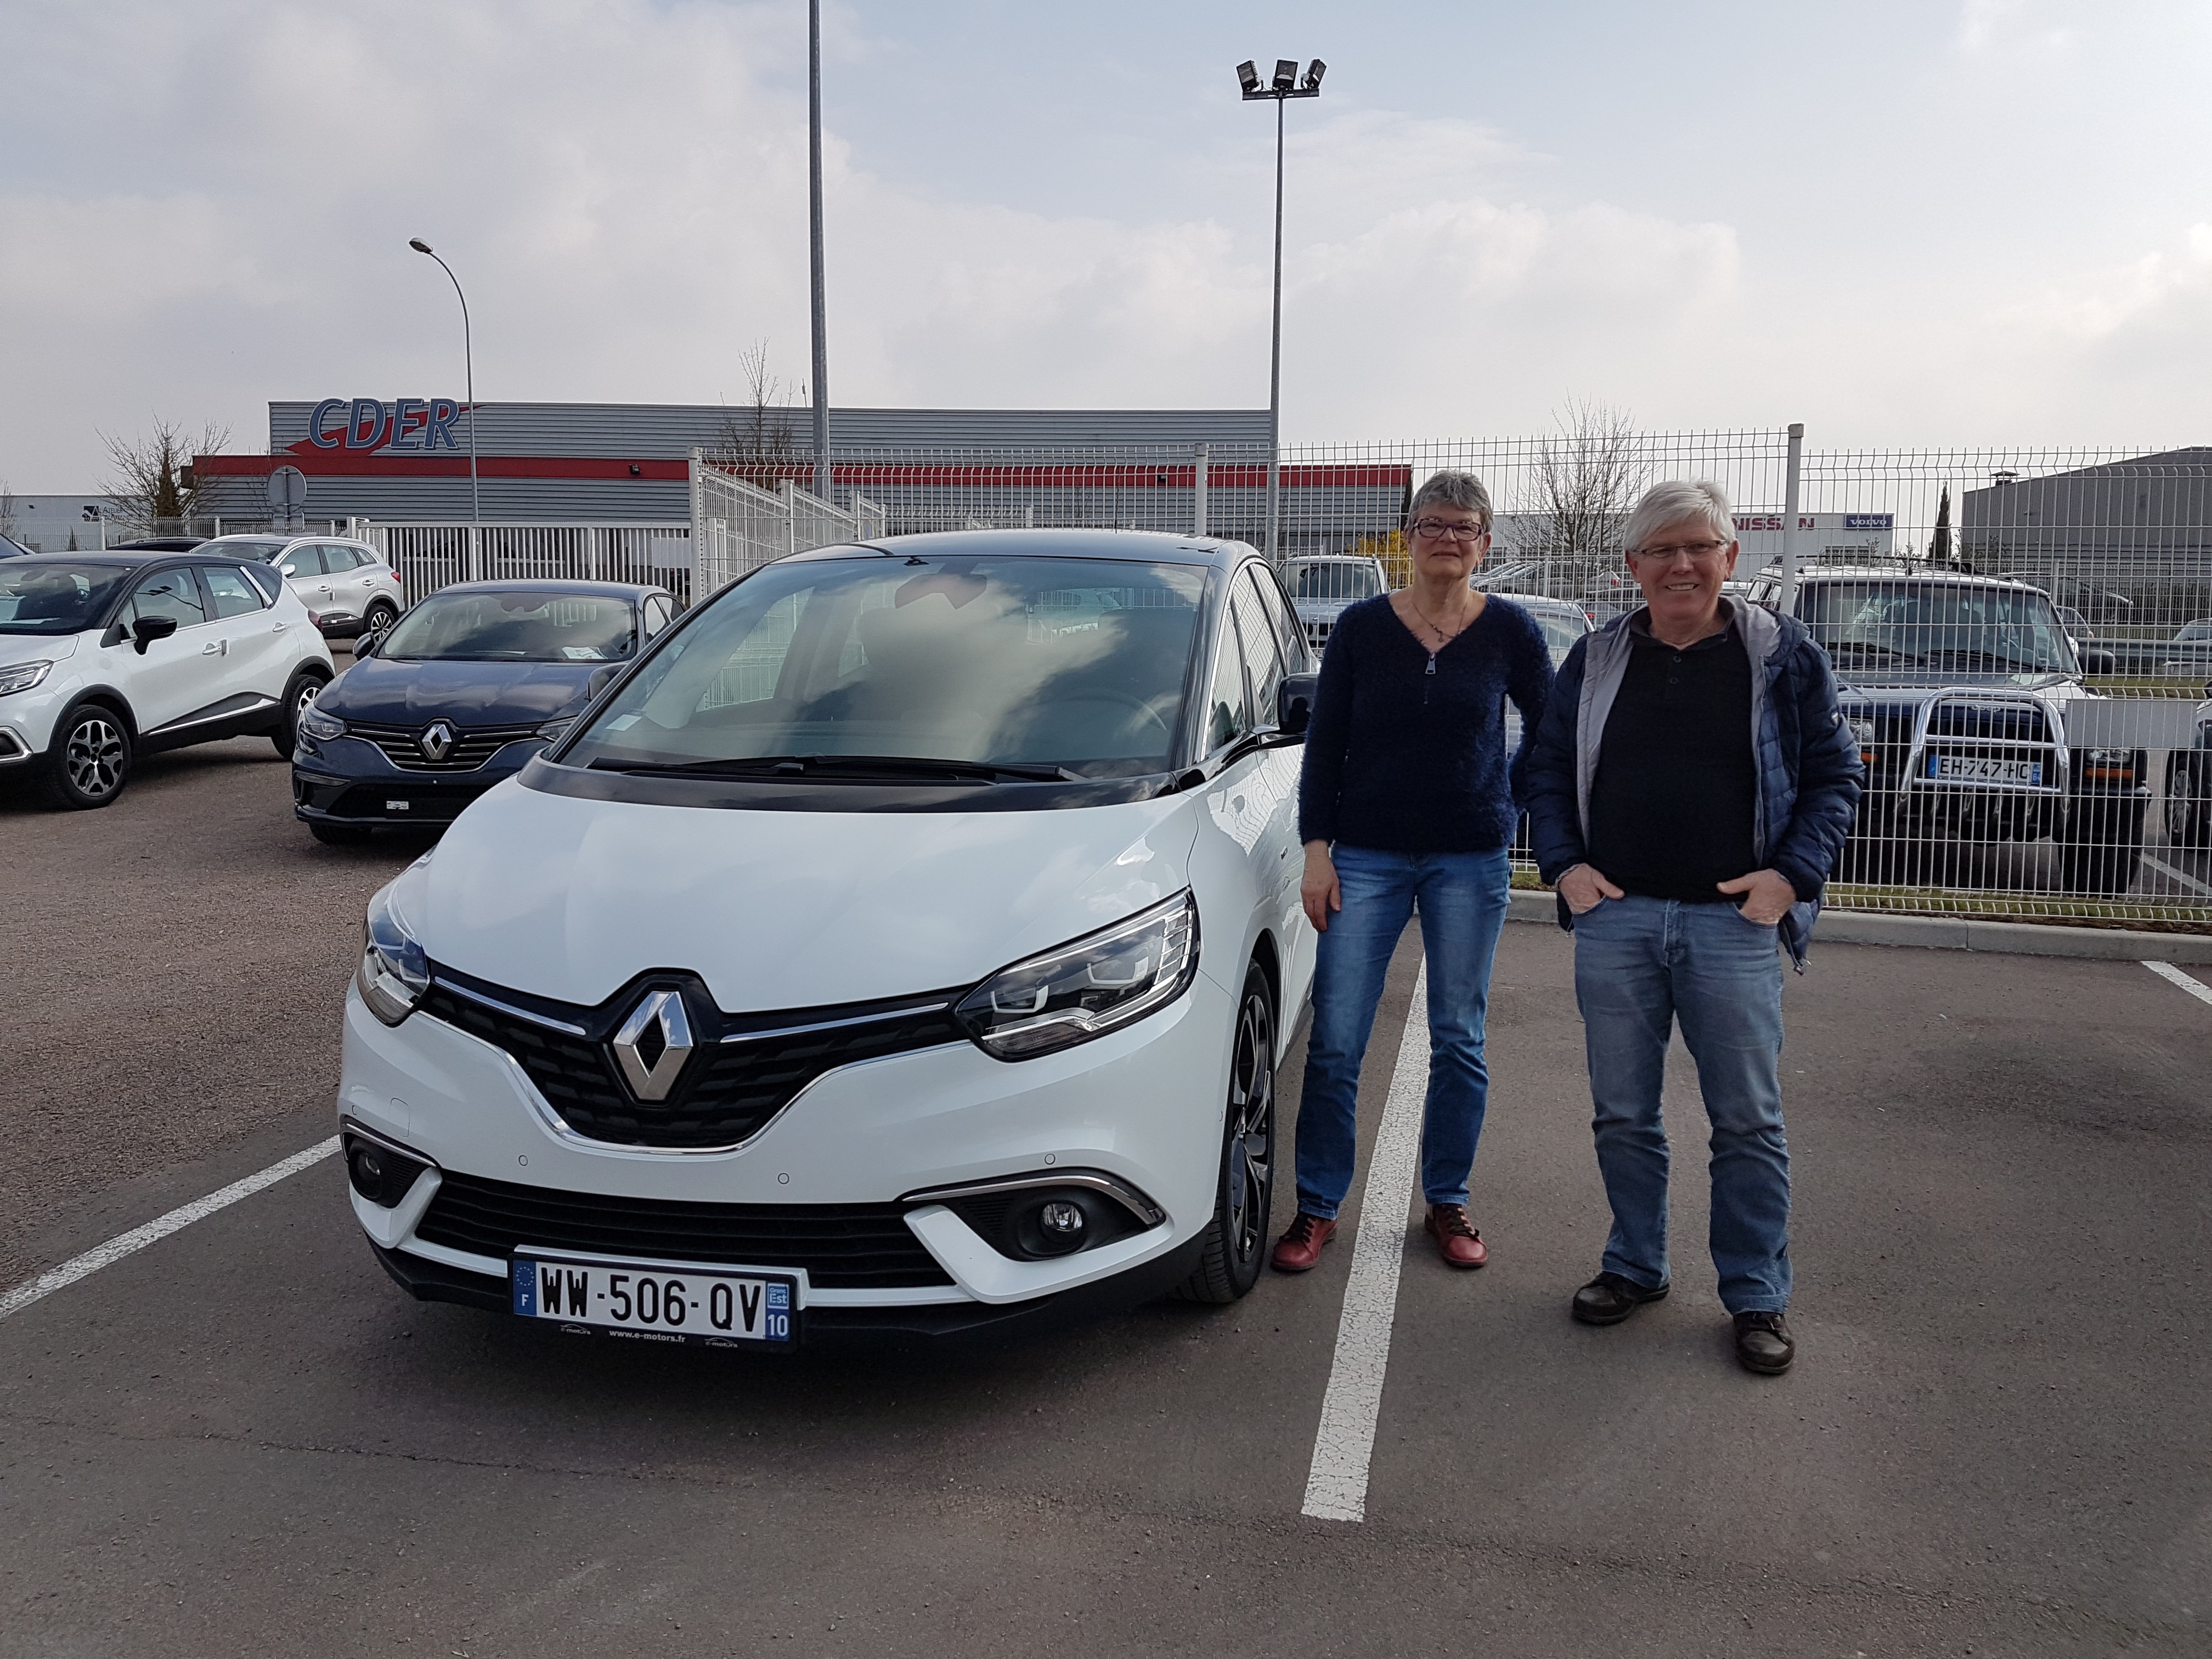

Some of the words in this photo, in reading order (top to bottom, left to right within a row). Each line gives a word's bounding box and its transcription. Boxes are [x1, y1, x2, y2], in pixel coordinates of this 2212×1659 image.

[308, 398, 460, 449] CDER
[1732, 517, 1815, 531] NISSN
[521, 1294, 528, 1306] F
[769, 1293, 787, 1304] Est
[768, 1313, 788, 1337] 10
[608, 1329, 686, 1344] www.e-motors.fr
